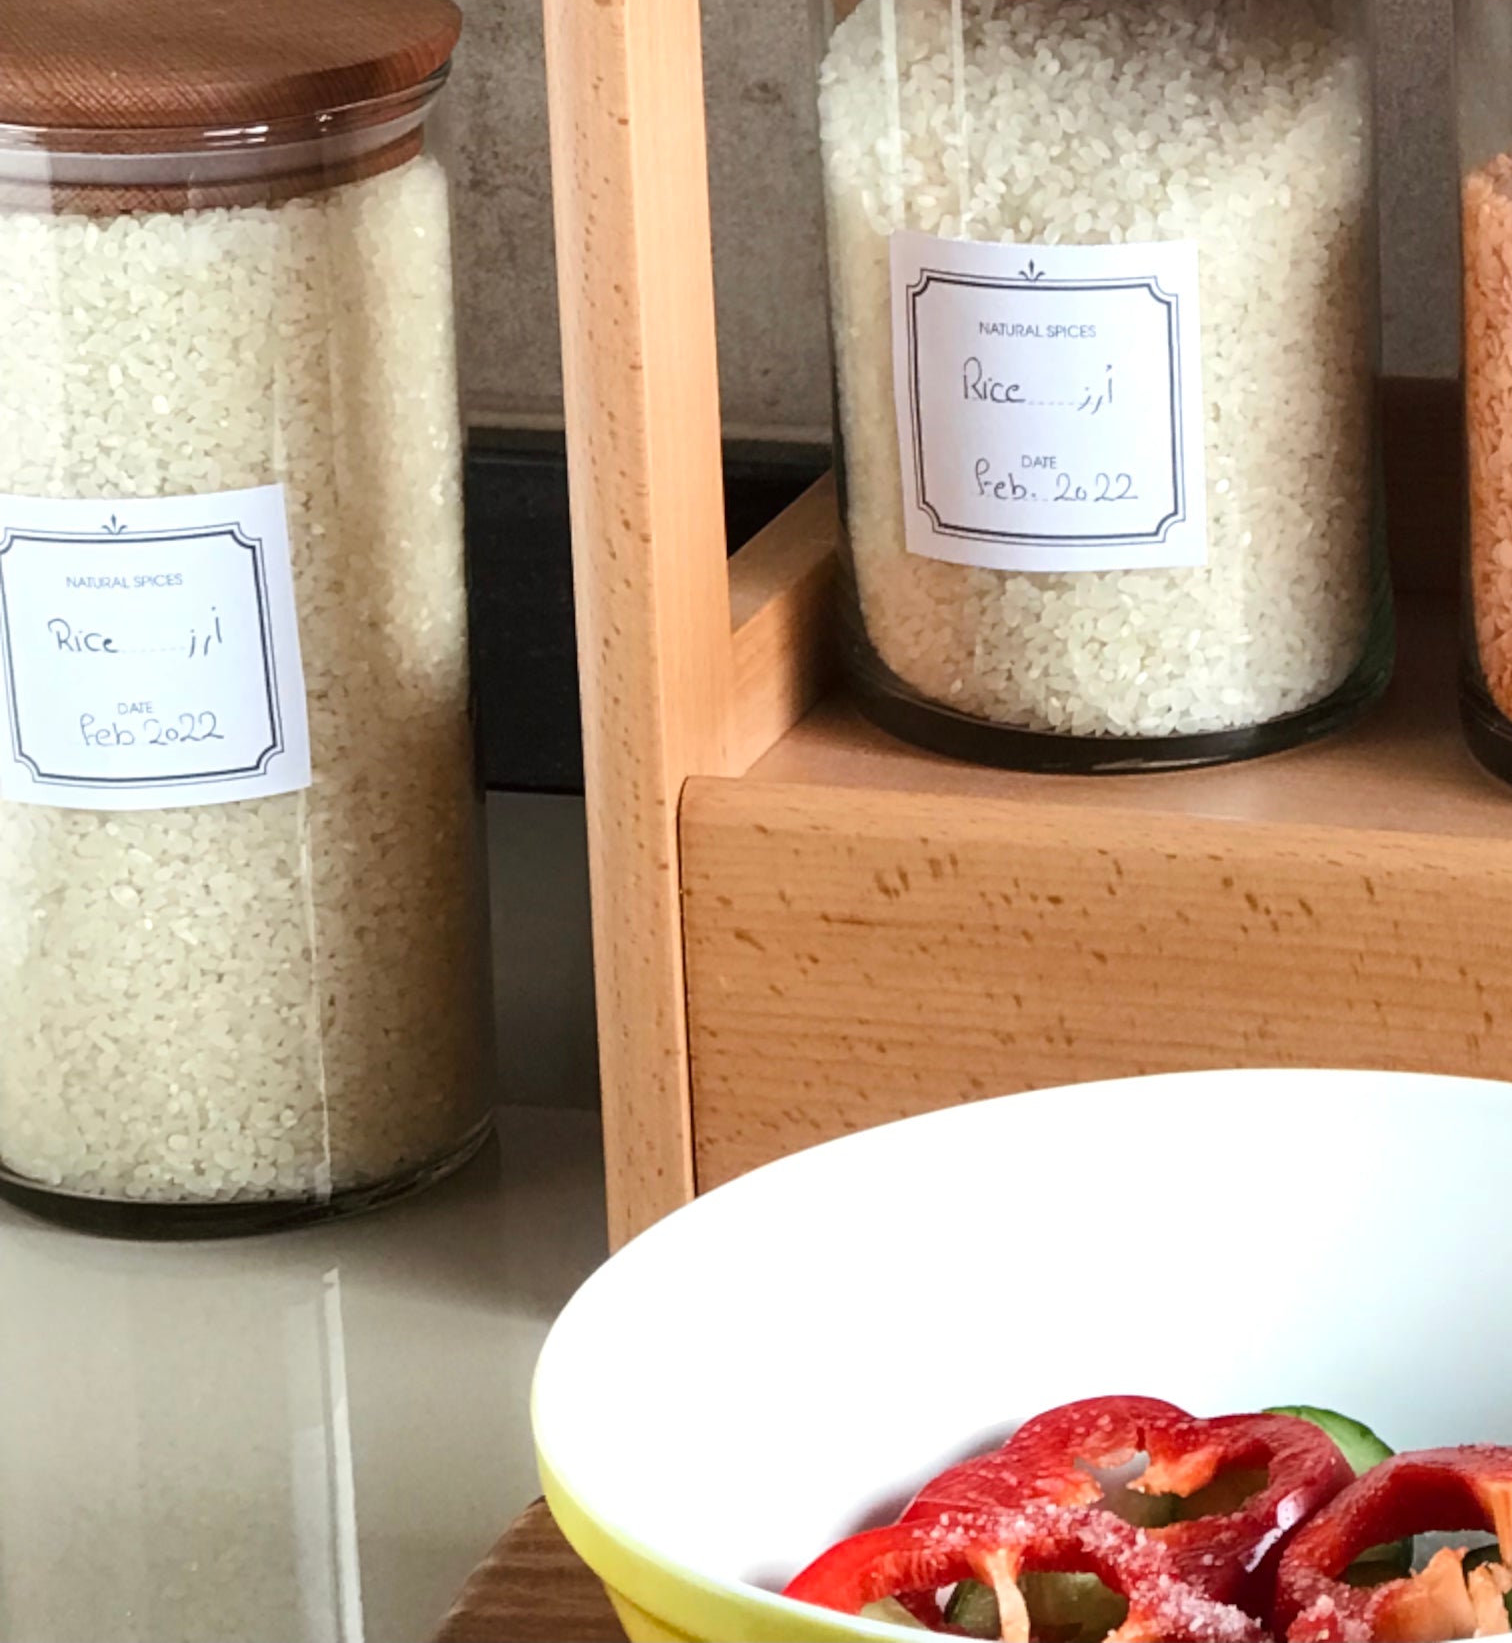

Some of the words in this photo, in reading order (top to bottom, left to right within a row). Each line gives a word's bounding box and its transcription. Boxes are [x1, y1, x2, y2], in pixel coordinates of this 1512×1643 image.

[979, 321, 1043, 338] NATURAL
[1045, 324, 1097, 339] SPICES
[962, 356, 1026, 403] Rice
[1021, 454, 1058, 470] DATE
[65, 575, 131, 589] NATURAL
[133, 572, 184, 587] SPICES
[47, 617, 120, 654] Rice
[116, 701, 154, 716] DATE
[143, 710, 225, 746] 2022
